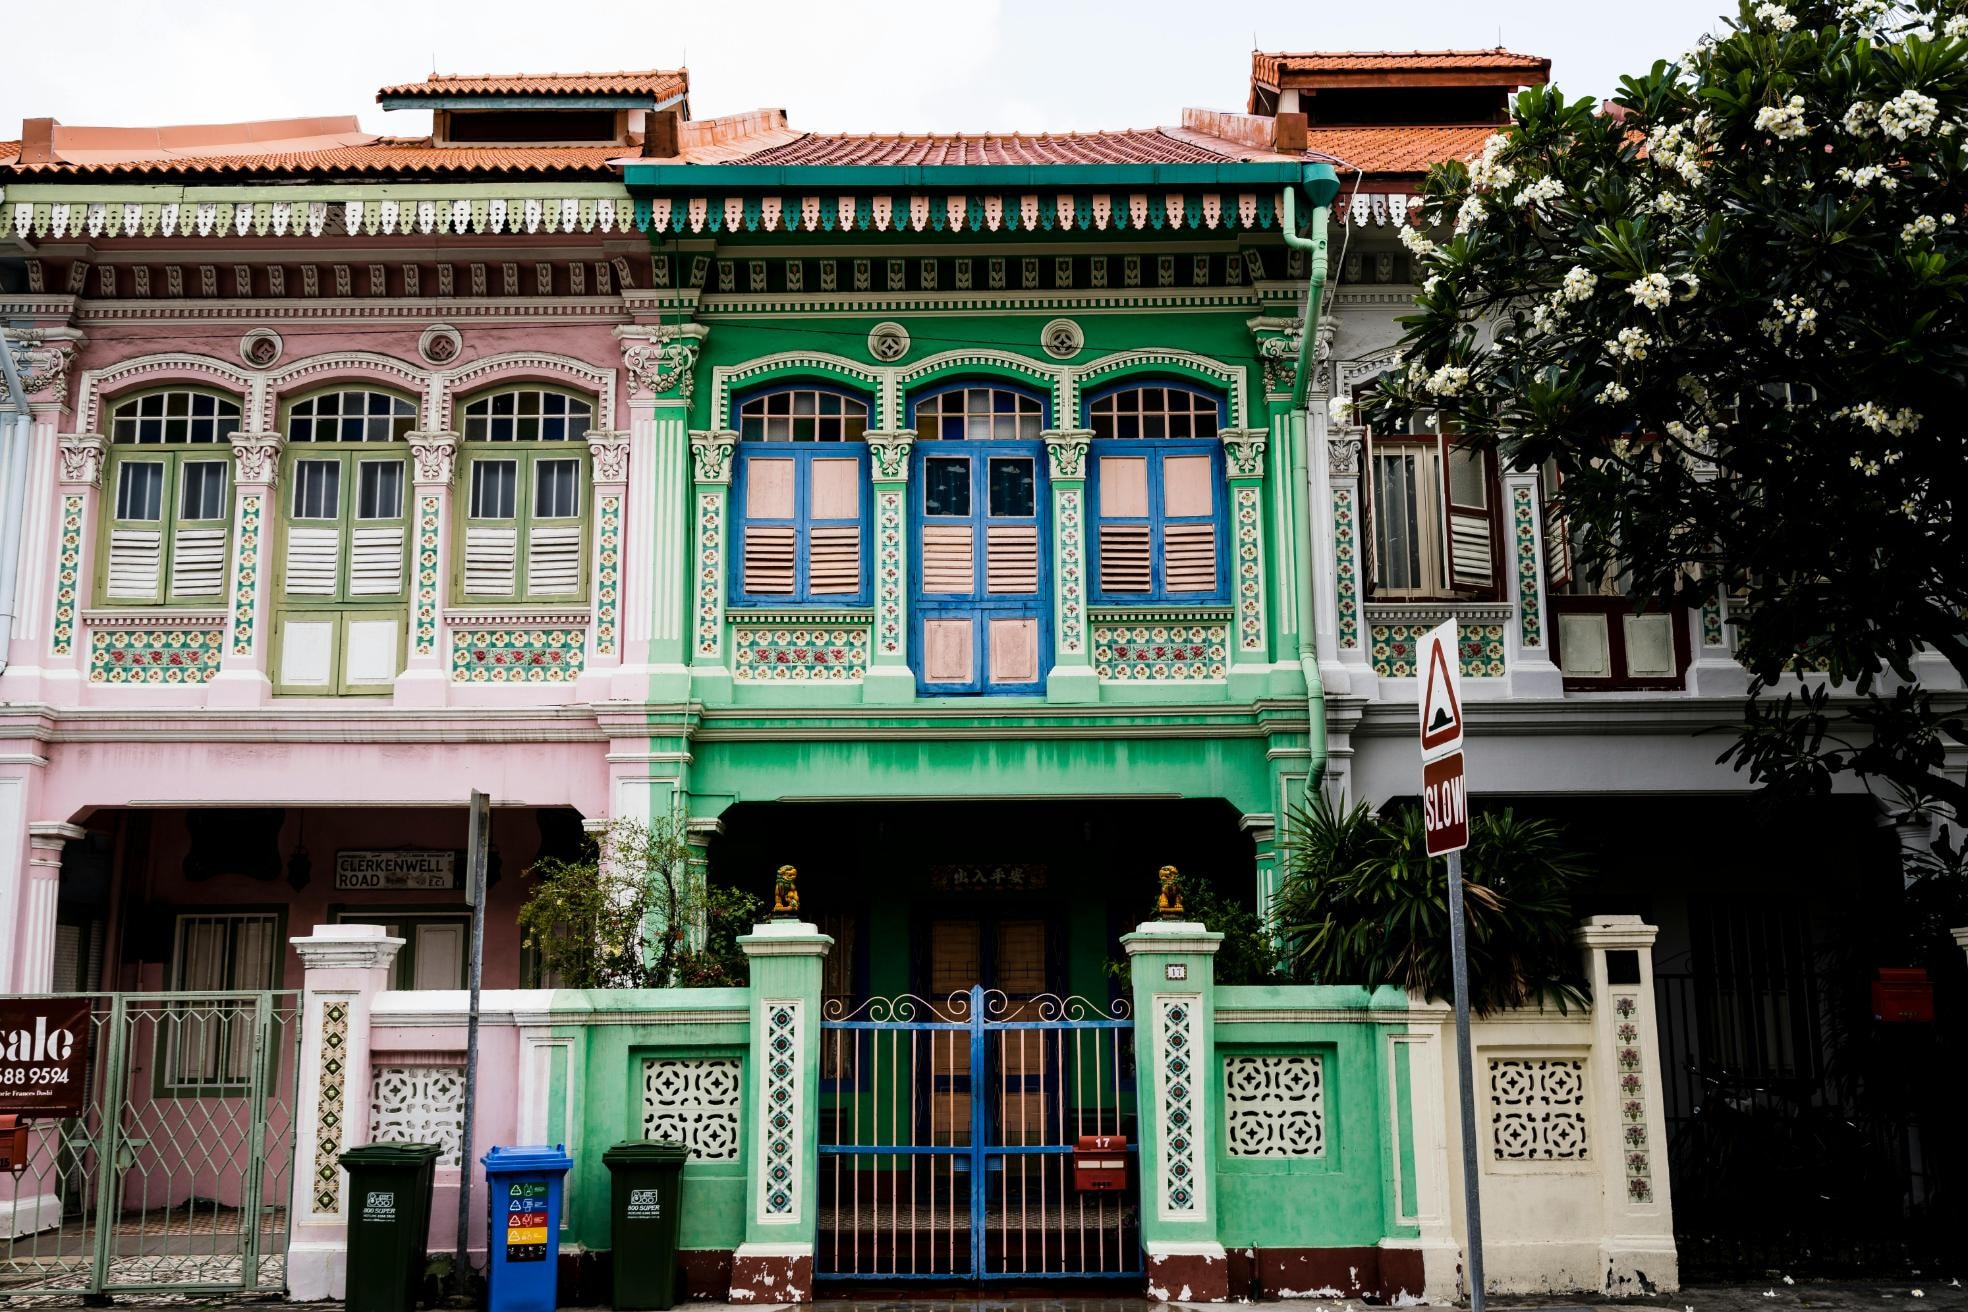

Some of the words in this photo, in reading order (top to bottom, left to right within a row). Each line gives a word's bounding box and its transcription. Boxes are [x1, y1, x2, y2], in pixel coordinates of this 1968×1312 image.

[1426, 775, 1463, 831] SLOW
[340, 860, 443, 872] CLERKENWELL
[339, 874, 380, 887] ROAD
[1172, 967, 1182, 976] 17
[29, 1067, 70, 1084] 9594
[1096, 1138, 1110, 1148] 17
